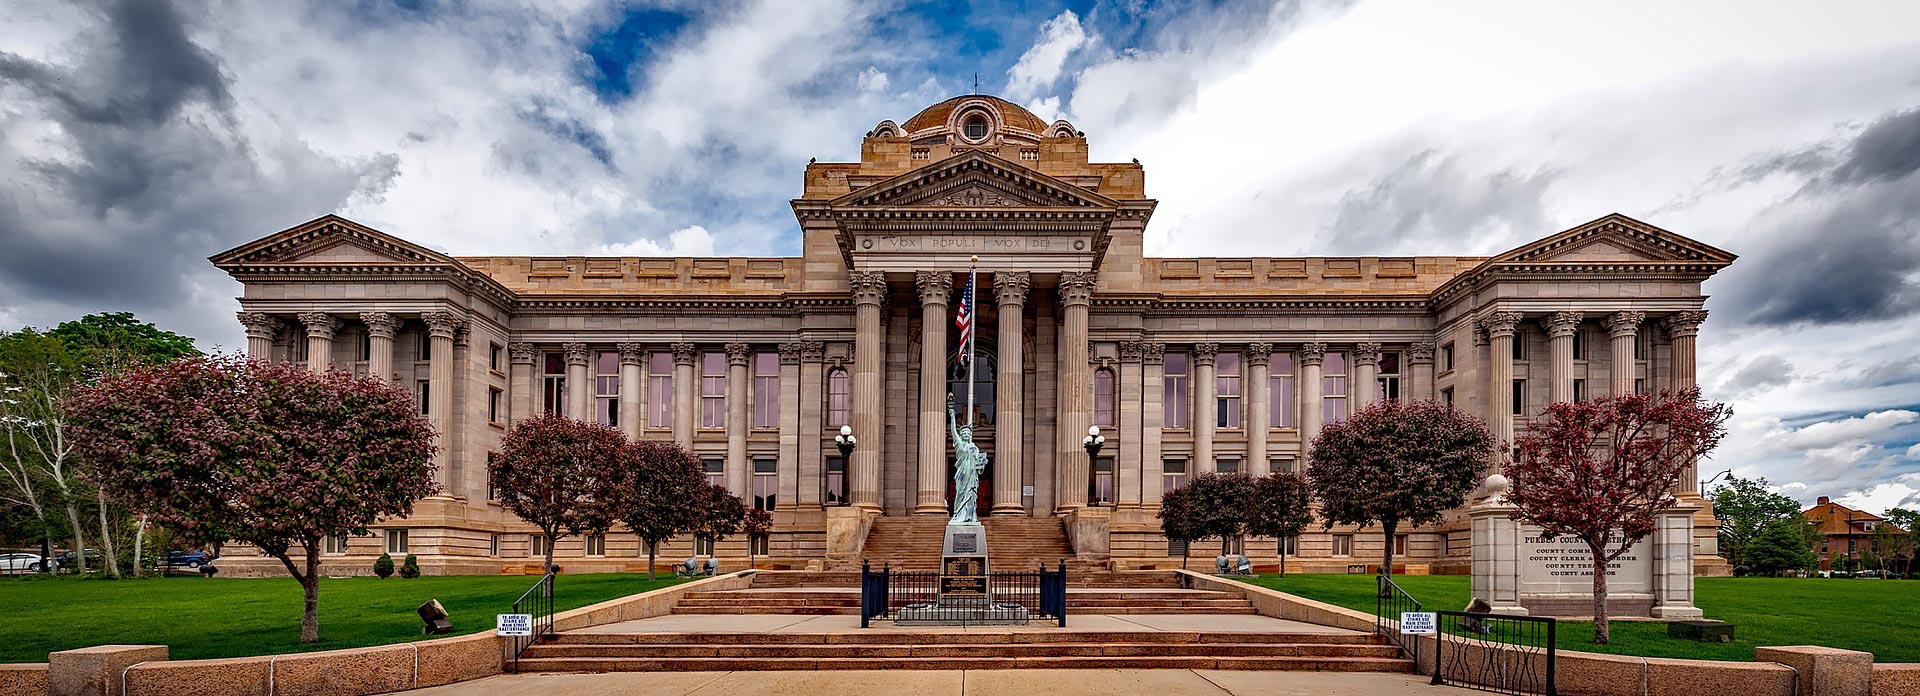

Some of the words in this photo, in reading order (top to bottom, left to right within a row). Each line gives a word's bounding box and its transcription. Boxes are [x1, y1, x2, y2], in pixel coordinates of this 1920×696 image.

[890, 239, 916, 248] VOX
[932, 239, 976, 248] POPULI
[994, 239, 1021, 248] VOX
[1033, 239, 1050, 248] DEI
